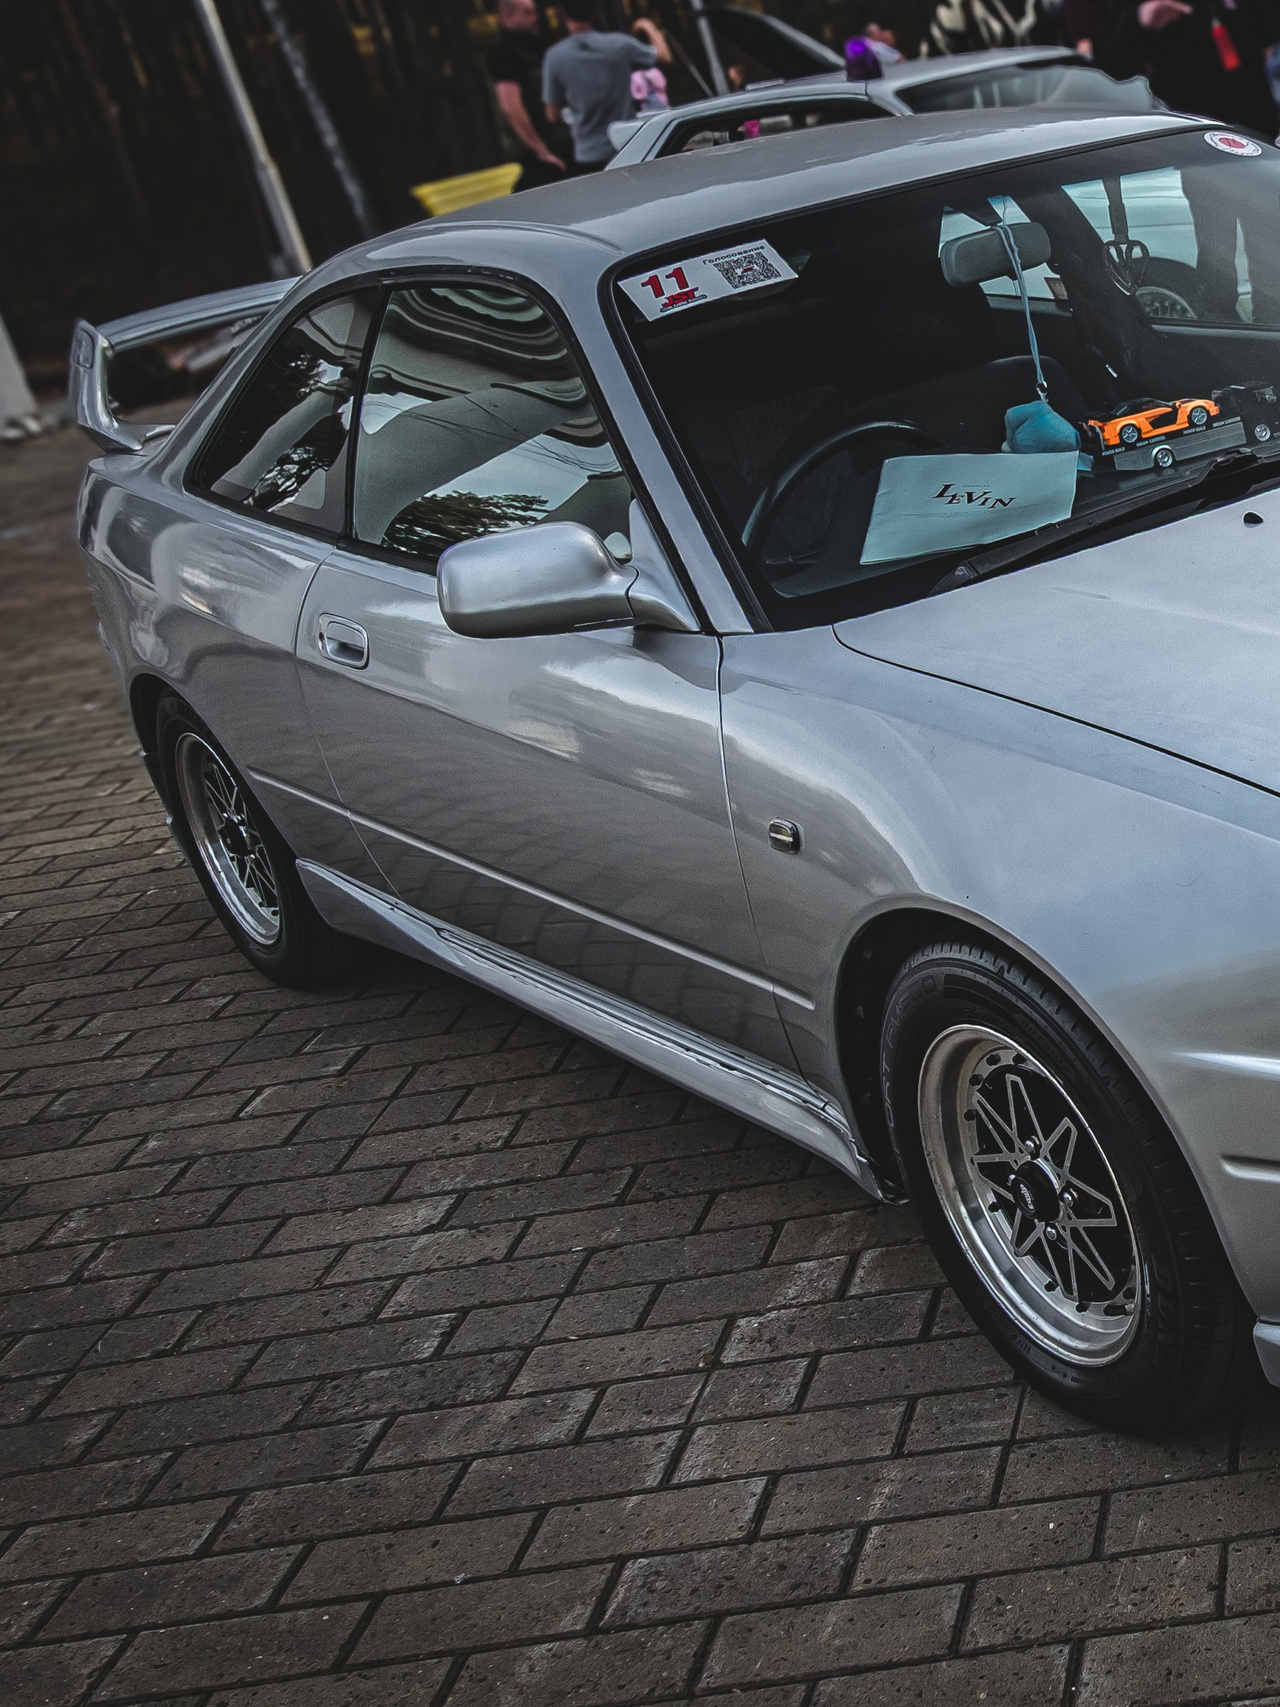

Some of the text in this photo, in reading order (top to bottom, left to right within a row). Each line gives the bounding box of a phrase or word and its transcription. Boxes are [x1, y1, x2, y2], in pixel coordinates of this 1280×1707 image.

[703, 245, 765, 265] Голосование
[640, 266, 690, 299] 11
[661, 287, 699, 308] JST
[932, 483, 1017, 510] LEVIN
